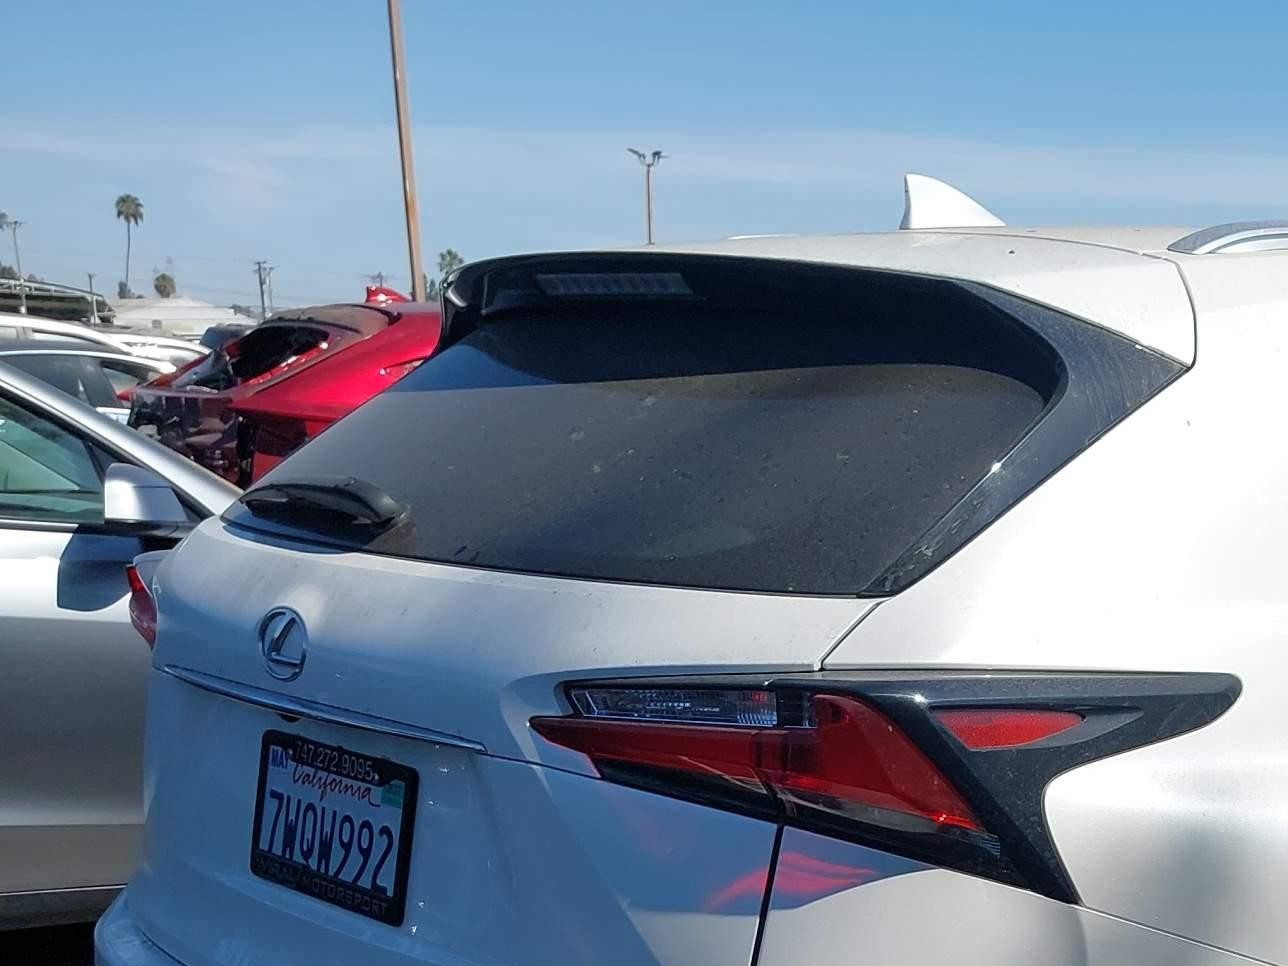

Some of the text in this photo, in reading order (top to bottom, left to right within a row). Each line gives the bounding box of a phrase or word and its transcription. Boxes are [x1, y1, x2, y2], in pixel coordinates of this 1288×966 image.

[270, 747, 290, 769] MAY
[292, 763, 382, 807] California
[268, 788, 395, 895] 7WQW992
